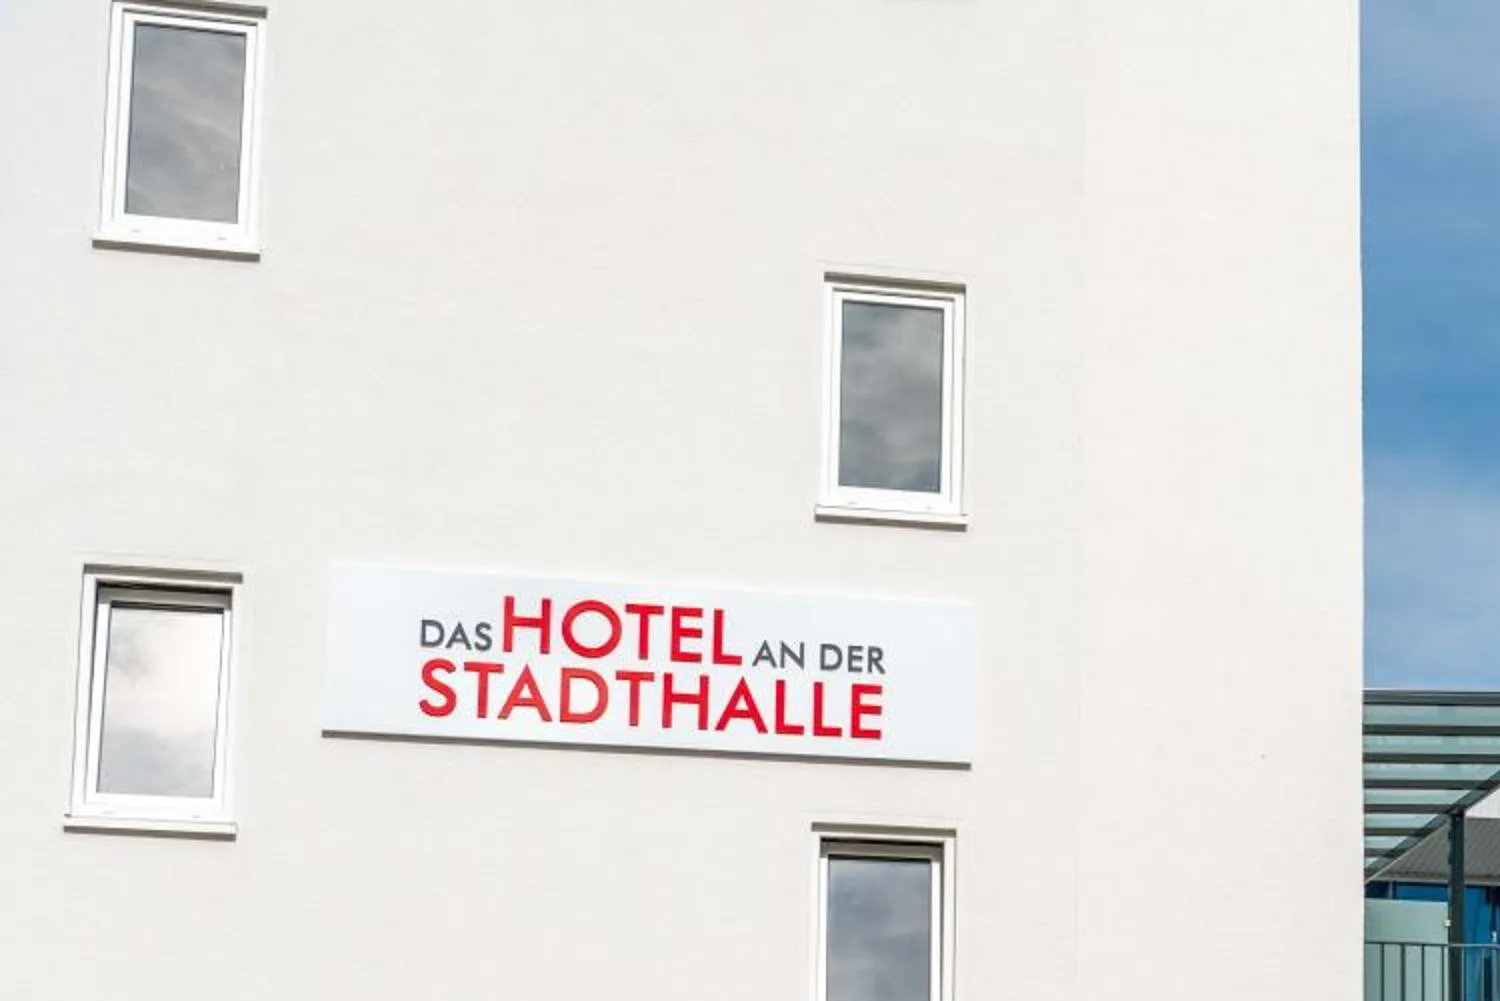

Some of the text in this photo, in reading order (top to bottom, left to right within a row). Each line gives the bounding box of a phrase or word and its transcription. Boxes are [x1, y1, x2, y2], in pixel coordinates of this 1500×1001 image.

[420, 595, 886, 674] DAS HOTEL AN DER
[419, 658, 883, 740] STADTHALLE
